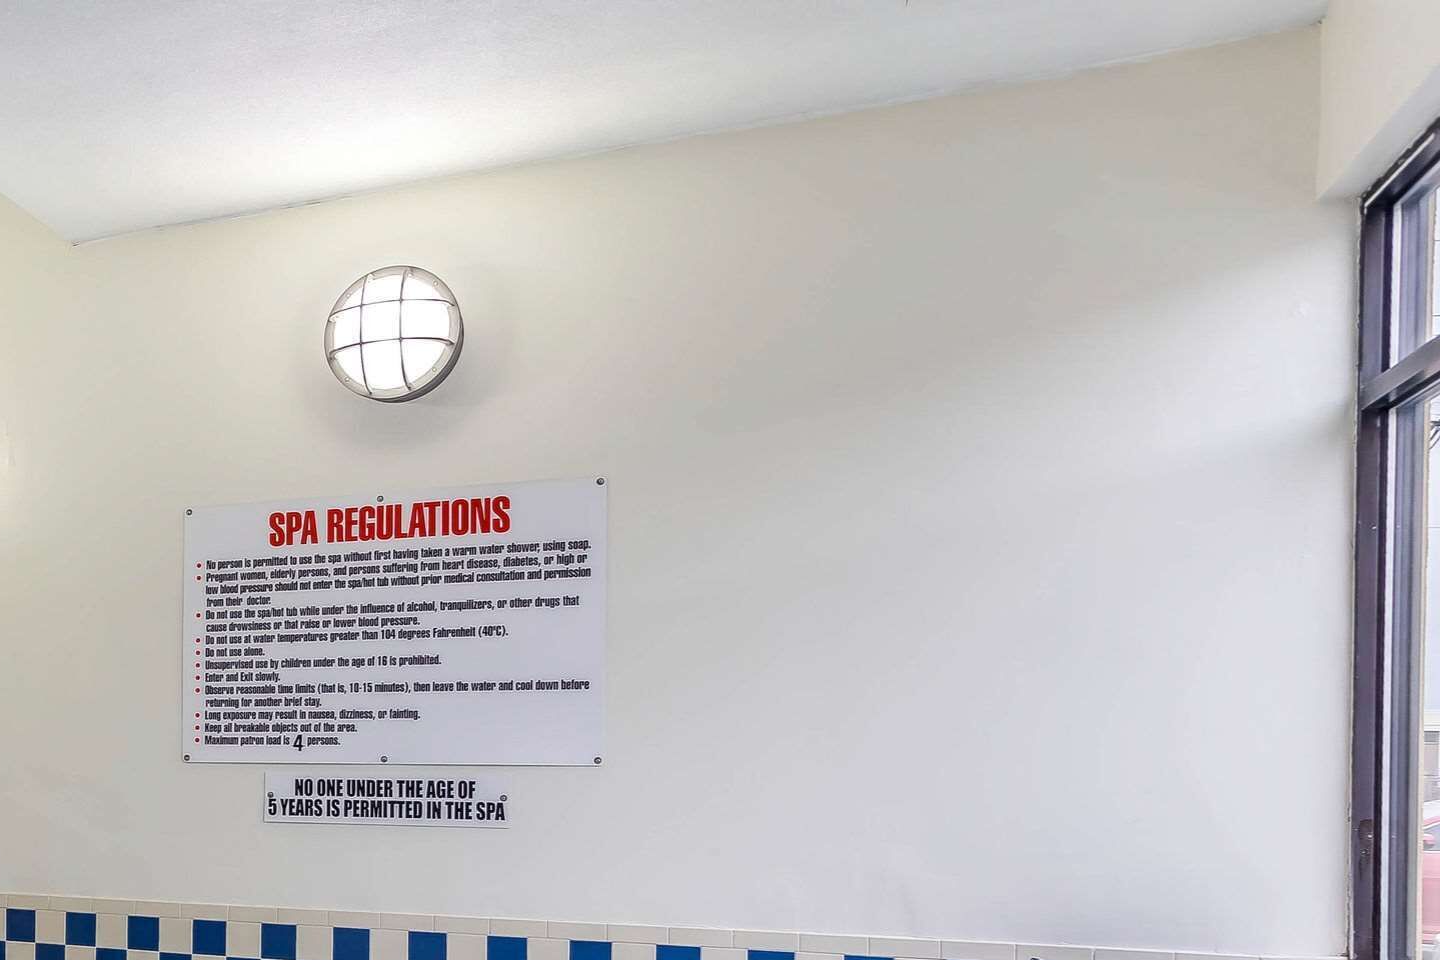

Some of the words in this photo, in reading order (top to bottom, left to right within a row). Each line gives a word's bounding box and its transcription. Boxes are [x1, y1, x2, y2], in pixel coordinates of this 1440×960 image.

[268, 510, 318, 547] SPA
[327, 496, 511, 543] REGULATIONS
[206, 560, 216, 570] No
[217, 560, 243, 571] person
[244, 558, 252, 568] is
[252, 556, 288, 568] permitted
[289, 556, 297, 565] to
[298, 556, 313, 565] use
[314, 554, 326, 564] the
[327, 554, 342, 564] spa
[343, 551, 372, 562] without
[374, 550, 391, 561] first
[392, 549, 419, 560] having
[420, 548, 443, 558] taken
[444, 548, 450, 557] a
[451, 547, 477, 556] warm
[478, 545, 505, 555] water
[506, 543, 541, 555] shower,
[542, 540, 566, 551] using
[567, 541, 592, 550] soap.
[206, 572, 239, 583] Pregnant
[240, 571, 269, 581] women,
[269, 568, 296, 580] elderly
[297, 568, 331, 579] persons,
[333, 565, 347, 576] and
[348, 565, 381, 576] persons
[382, 562, 419, 573] suffering
[420, 561, 440, 571] from
[442, 560, 465, 570] heart
[466, 559, 501, 569] disease,
[503, 557, 542, 567] diabetes,
[543, 556, 554, 565] or
[556, 553, 575, 565] high
[576, 555, 588, 564] or
[205, 610, 215, 620] Do
[216, 610, 228, 619] not
[229, 610, 243, 619] use
[244, 608, 256, 618] the
[257, 607, 284, 619] spa/hot
[286, 606, 298, 617] tub
[299, 605, 320, 616] while
[321, 605, 345, 615] under
[346, 604, 359, 614] the
[360, 603, 395, 614] influence
[396, 602, 405, 613] of
[406, 601, 438, 612] alcohol,
[440, 600, 496, 611] tranquilizers,
[497, 600, 508, 609] or
[509, 598, 533, 608] other
[534, 597, 561, 608] drugs
[562, 596, 580, 606] that
[206, 597, 224, 607] from
[225, 596, 243, 607] their
[246, 595, 271, 605] doctor.
[206, 623, 228, 632] cause
[228, 621, 272, 631] drowsiness
[273, 621, 283, 630] or
[284, 620, 299, 630] that
[300, 619, 321, 629] raise
[322, 619, 332, 628] or
[333, 618, 357, 628] lower
[358, 617, 379, 627] blood
[380, 617, 421, 628] pressure.
[205, 635, 215, 645] Do
[216, 635, 228, 645] not
[229, 635, 242, 644] use
[243, 634, 252, 644] at
[252, 634, 276, 643] water
[277, 633, 328, 643] temperatures
[329, 631, 360, 643] greater
[361, 630, 378, 640] than
[381, 629, 396, 640] 104
[398, 629, 431, 640] degrees
[432, 627, 476, 638] Fahrenheit
[205, 647, 215, 658] Do
[216, 648, 228, 657] not
[229, 648, 242, 657] use
[243, 646, 265, 656] alone.
[205, 659, 254, 671] Unsupervised
[255, 660, 268, 669] use
[270, 658, 279, 670] by
[280, 658, 312, 668] children
[313, 657, 336, 667] under
[337, 657, 350, 667] the
[351, 658, 366, 668] age
[367, 656, 375, 666] of
[389, 656, 397, 666] is
[398, 655, 442, 667] prohibited.
[205, 672, 224, 683] Enter
[225, 672, 239, 682] and
[240, 671, 254, 682] Exit
[254, 671, 281, 683] slowly.
[204, 685, 235, 695] Observe
[236, 684, 276, 694] reasonable
[277, 684, 294, 694] time
[295, 683, 316, 694] limits
[317, 683, 336, 694] (that
[337, 683, 347, 694] is,
[349, 682, 373, 693] 10-15
[374, 682, 411, 693] minutes),
[413, 682, 431, 692] then
[432, 682, 454, 692] leave
[456, 681, 469, 692] the
[470, 681, 497, 691] water
[498, 681, 514, 691] and
[515, 680, 533, 691] cool
[535, 680, 559, 690] down
[561, 680, 590, 690] before
[204, 710, 221, 723] Long
[222, 711, 257, 722] exposure
[258, 711, 274, 723] may
[275, 710, 298, 720] result
[299, 709, 307, 719] in
[308, 711, 337, 722] nausea,
[339, 709, 376, 720] dizziness,
[377, 710, 388, 719] or
[389, 709, 421, 720] fainting.
[204, 723, 222, 734] Keep
[223, 722, 233, 733] all
[234, 722, 270, 732] breakable
[271, 722, 298, 733] objects
[300, 723, 312, 733] out
[313, 722, 322, 733] of
[323, 722, 335, 732] the
[337, 723, 358, 732] area.
[204, 735, 239, 745] Maximum
[240, 736, 264, 746] patron
[266, 735, 282, 745] load
[283, 735, 290, 745] is
[293, 734, 304, 752] 4
[307, 736, 341, 746] persons.
[295, 778, 312, 797] NO
[317, 779, 343, 797] ONE
[346, 779, 393, 798] UNDER
[396, 780, 423, 798] THE
[426, 780, 454, 799] AGE
[458, 780, 476, 799] OF
[268, 798, 277, 816] 5
[280, 799, 323, 816] YEARS
[326, 800, 340, 817] IS
[344, 800, 423, 819] PERMITTED
[426, 801, 442, 819] IN
[445, 802, 473, 820] THE
[476, 802, 506, 821] SPA
